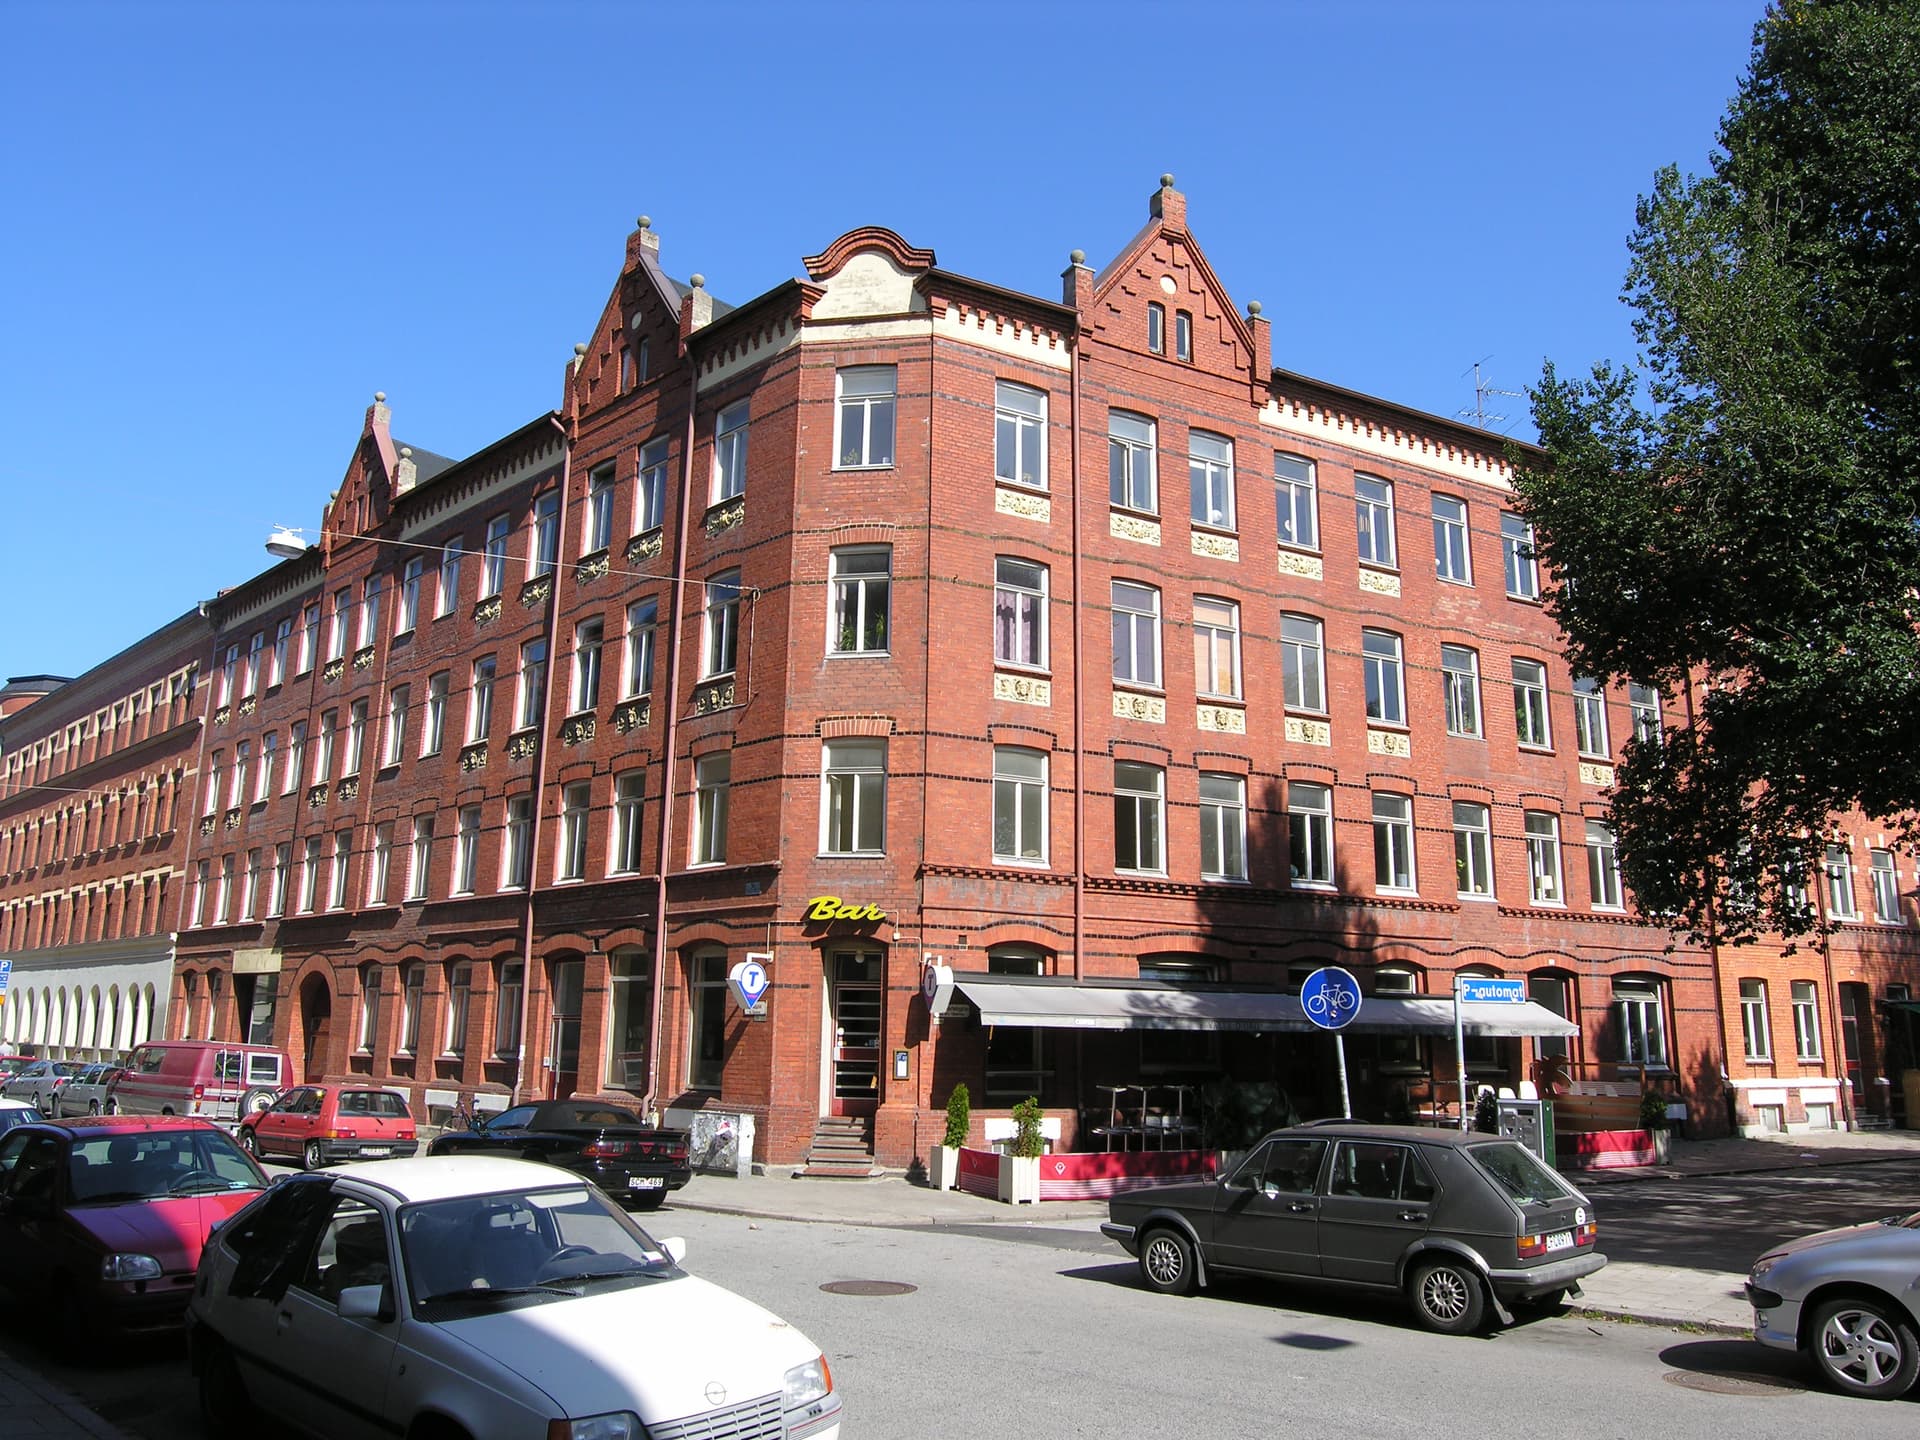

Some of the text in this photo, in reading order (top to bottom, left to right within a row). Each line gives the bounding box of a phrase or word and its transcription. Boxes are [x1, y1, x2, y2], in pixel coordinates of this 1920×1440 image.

[809, 896, 886, 920] Bar
[749, 971, 759, 987] T
[1463, 983, 1523, 998] P-automat
